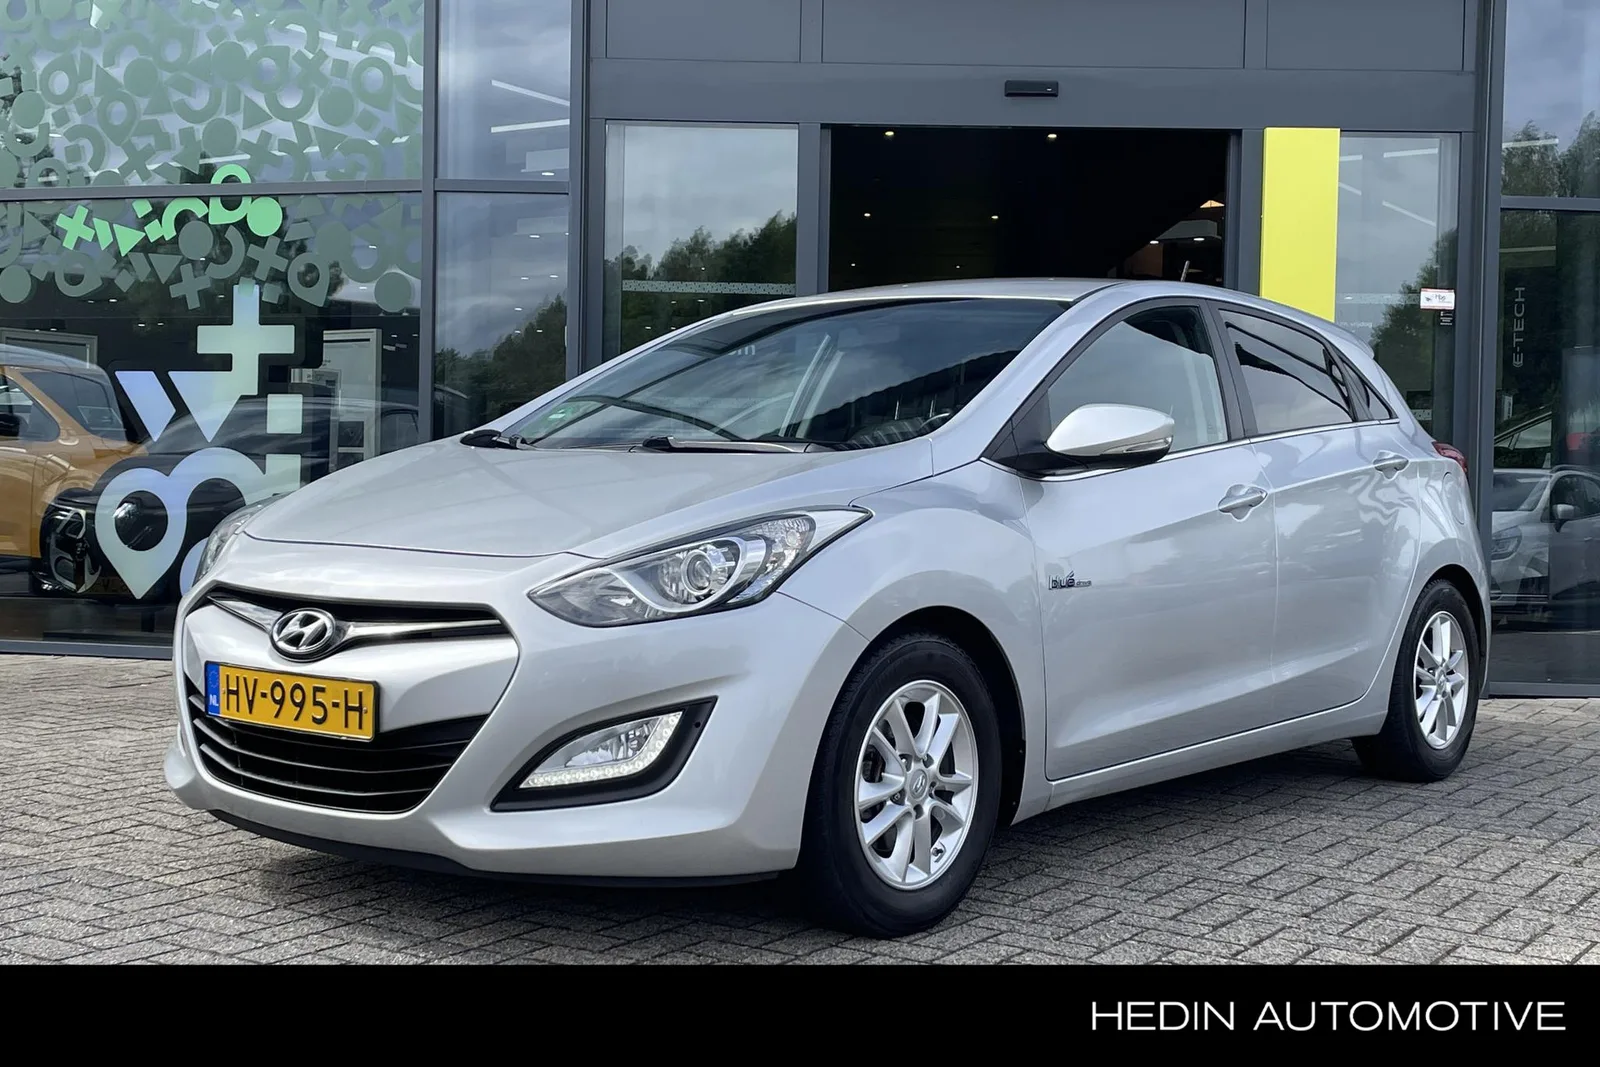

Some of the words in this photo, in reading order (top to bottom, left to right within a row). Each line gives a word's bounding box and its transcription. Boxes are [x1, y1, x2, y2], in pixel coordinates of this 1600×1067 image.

[1512, 287, 1525, 367] E-TECH
[209, 694, 219, 707] NL
[225, 673, 363, 730] HV-995-H
